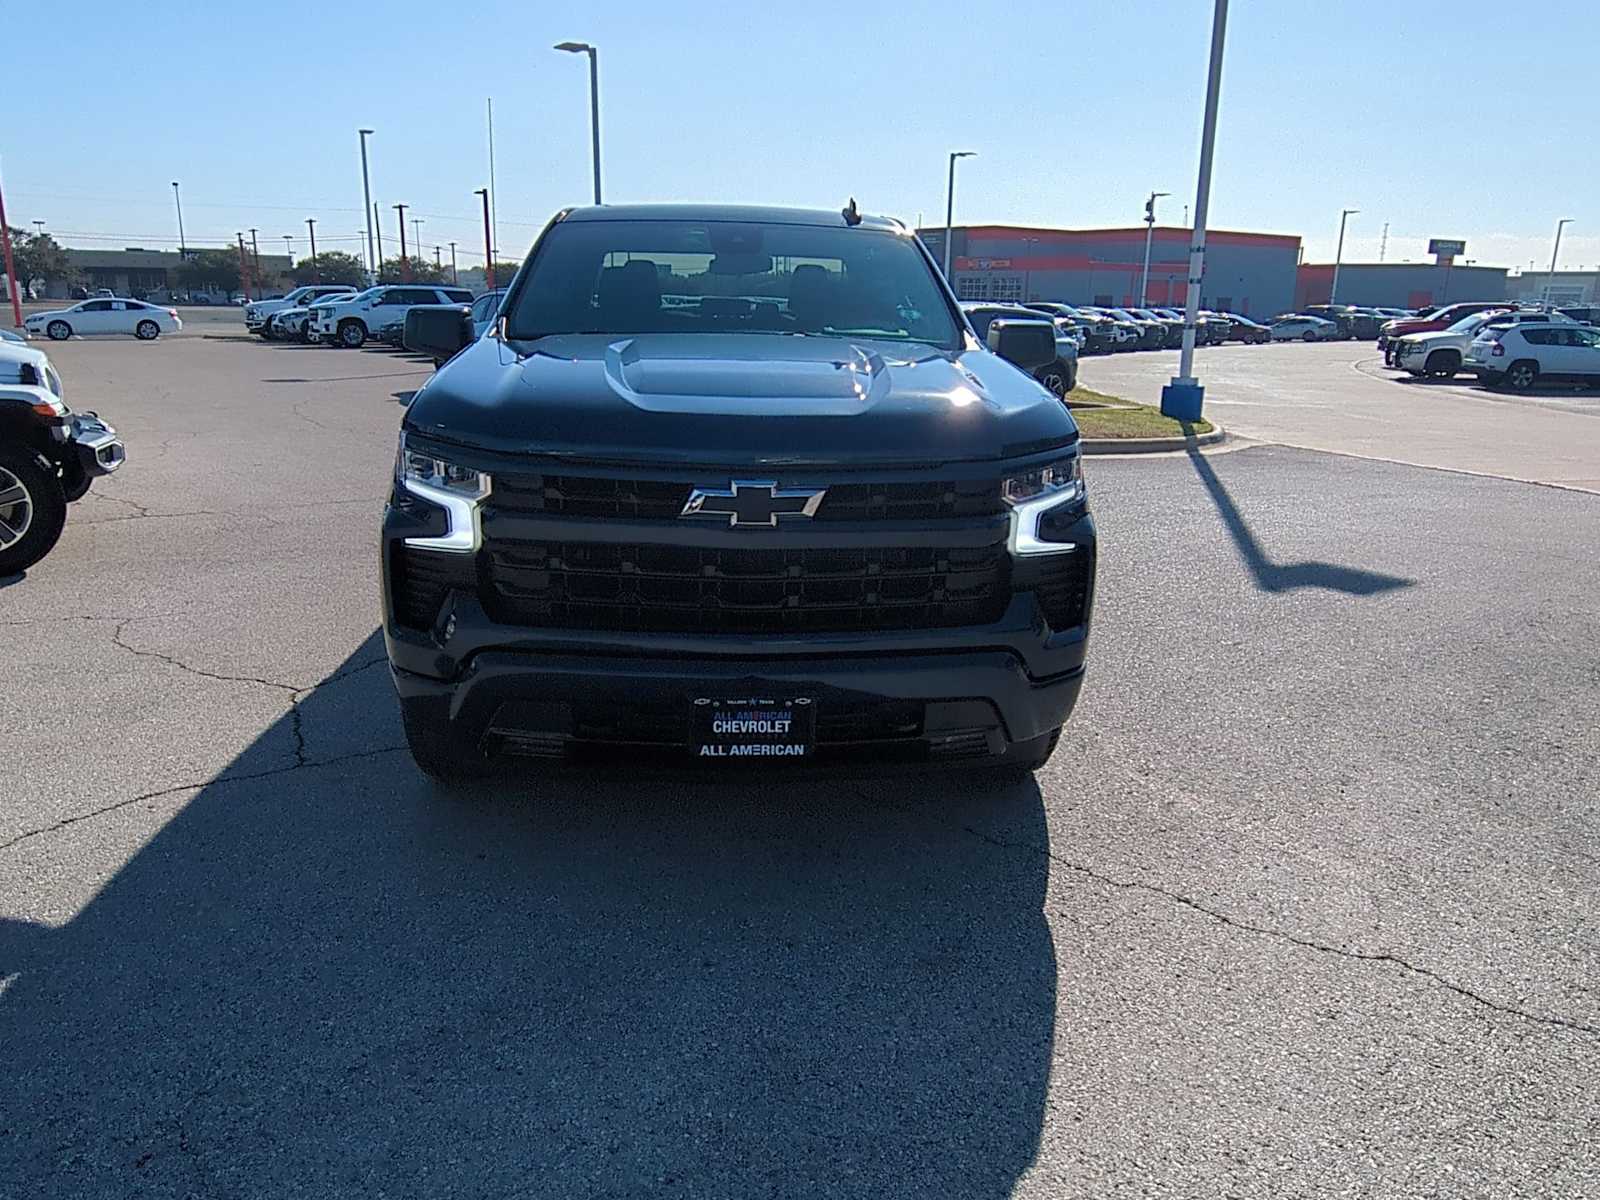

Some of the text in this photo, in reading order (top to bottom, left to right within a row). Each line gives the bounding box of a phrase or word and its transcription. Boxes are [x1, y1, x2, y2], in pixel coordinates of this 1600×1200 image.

[714, 711, 792, 720] ALL AMERICAN
[712, 720, 791, 732] CHEVROLET
[700, 744, 805, 756] ALL AMERICAN
